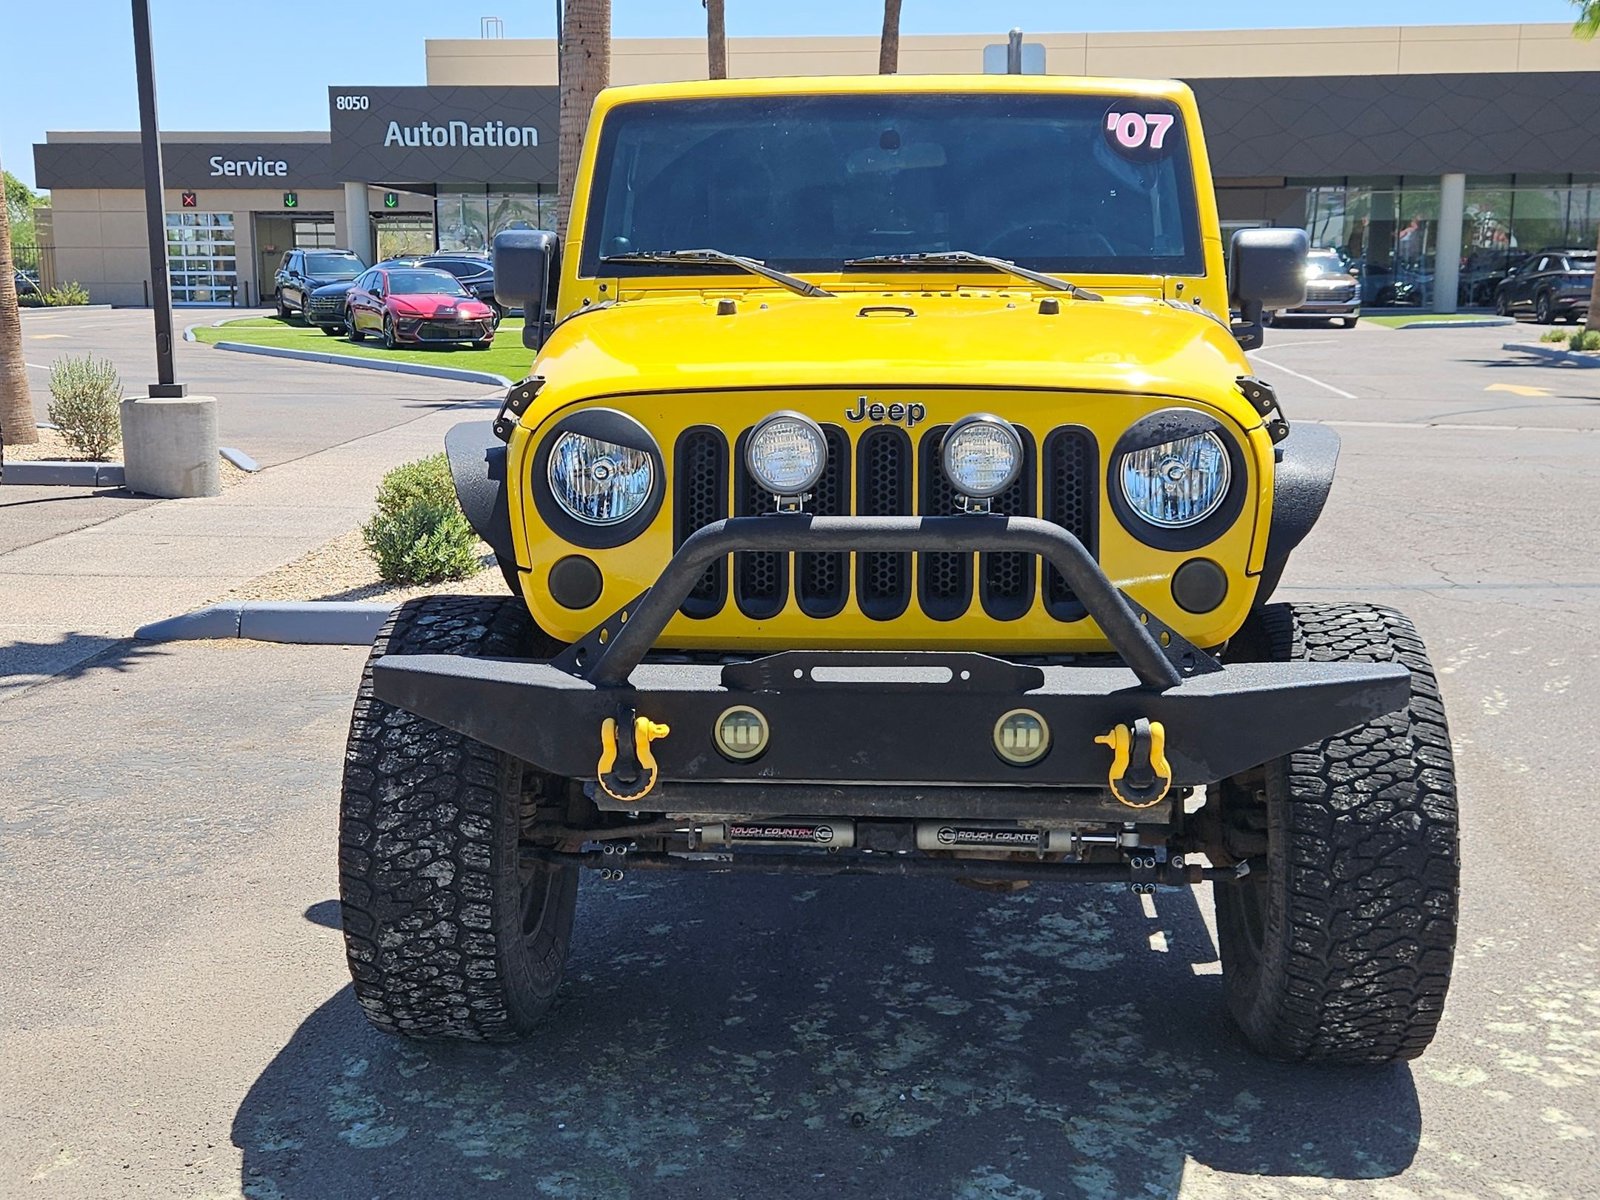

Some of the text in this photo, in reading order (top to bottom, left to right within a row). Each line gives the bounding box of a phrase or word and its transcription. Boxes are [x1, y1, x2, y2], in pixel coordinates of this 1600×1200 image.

[336, 96, 369, 110] 8050
[384, 120, 538, 147] AutoNation
[1107, 112, 1174, 149] '07
[210, 156, 287, 177] Service
[845, 396, 927, 428] Jeep
[765, 827, 813, 836] COUNTRY
[958, 831, 993, 839] ROUGH
[995, 832, 1040, 841] COUNTR
